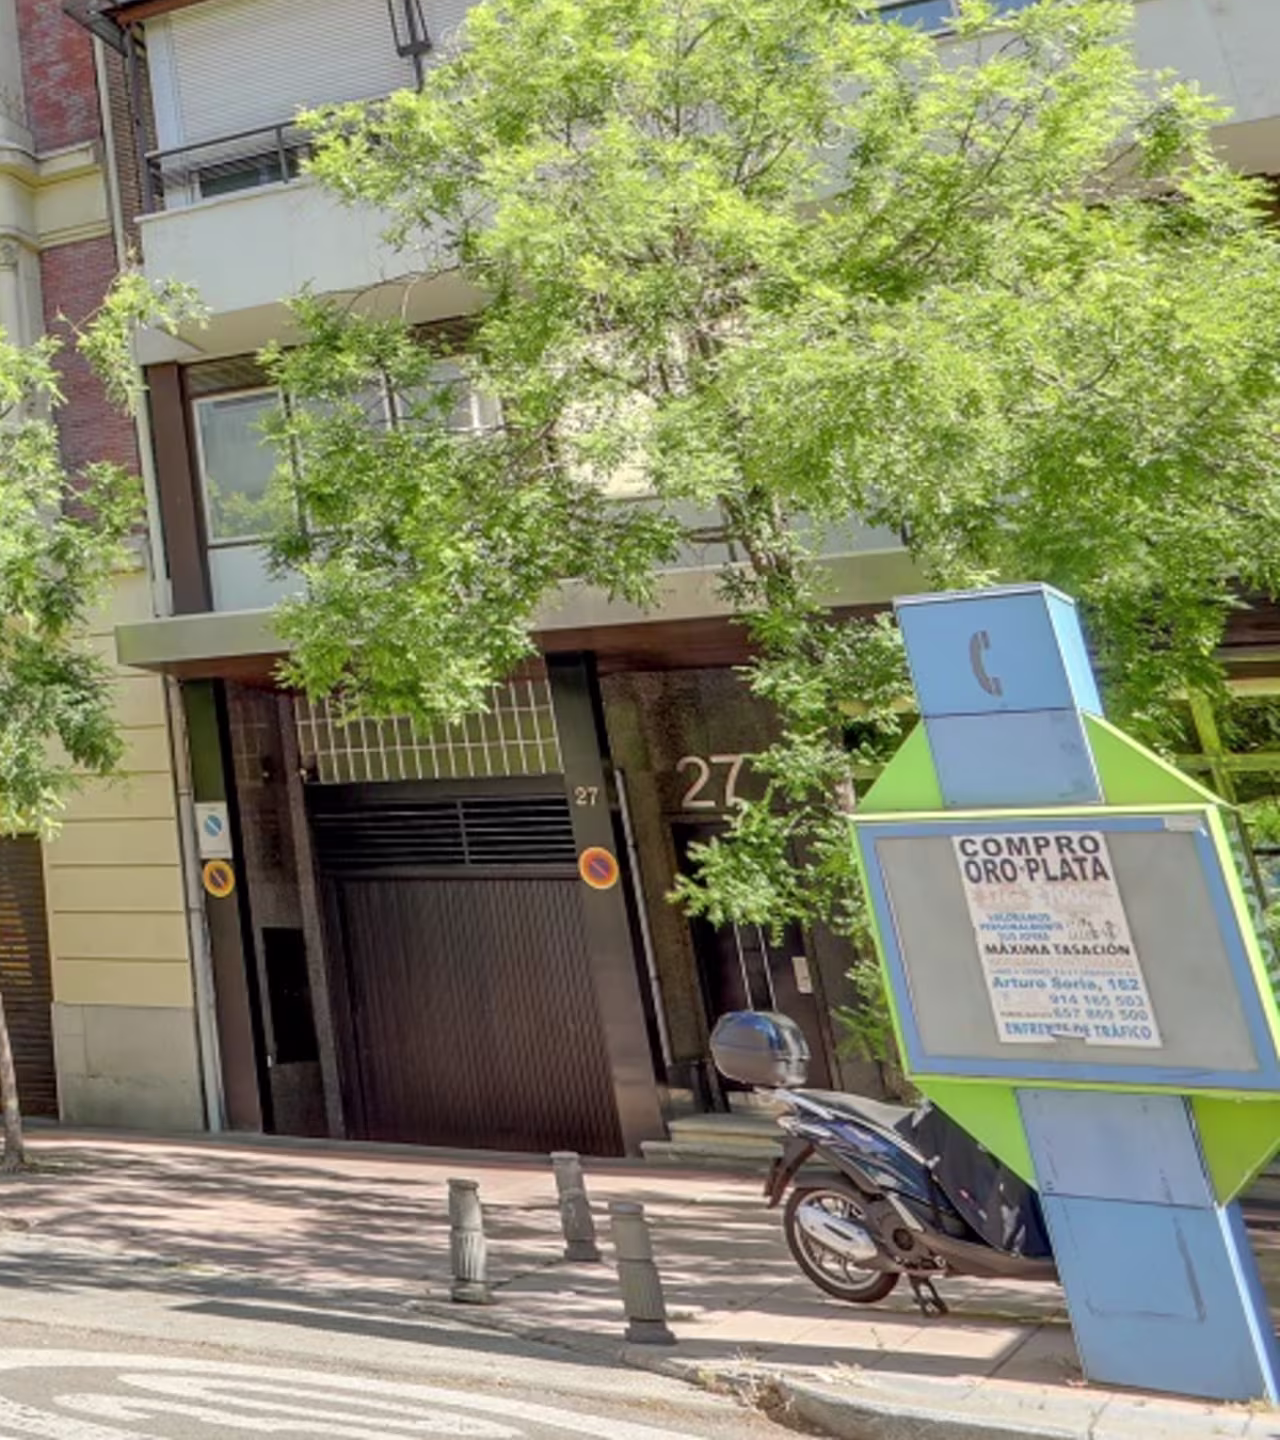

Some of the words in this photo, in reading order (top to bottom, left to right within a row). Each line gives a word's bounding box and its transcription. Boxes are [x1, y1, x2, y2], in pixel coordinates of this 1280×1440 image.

[676, 754, 743, 808] 27
[574, 786, 598, 806] 27
[959, 835, 1100, 857] COMPRO
[984, 941, 1051, 955] MÁXIMA
[1053, 941, 1131, 956] TASACIÓN
[992, 976, 1047, 989] Arturo
[1093, 1023, 1153, 1041] TRÁFICO
